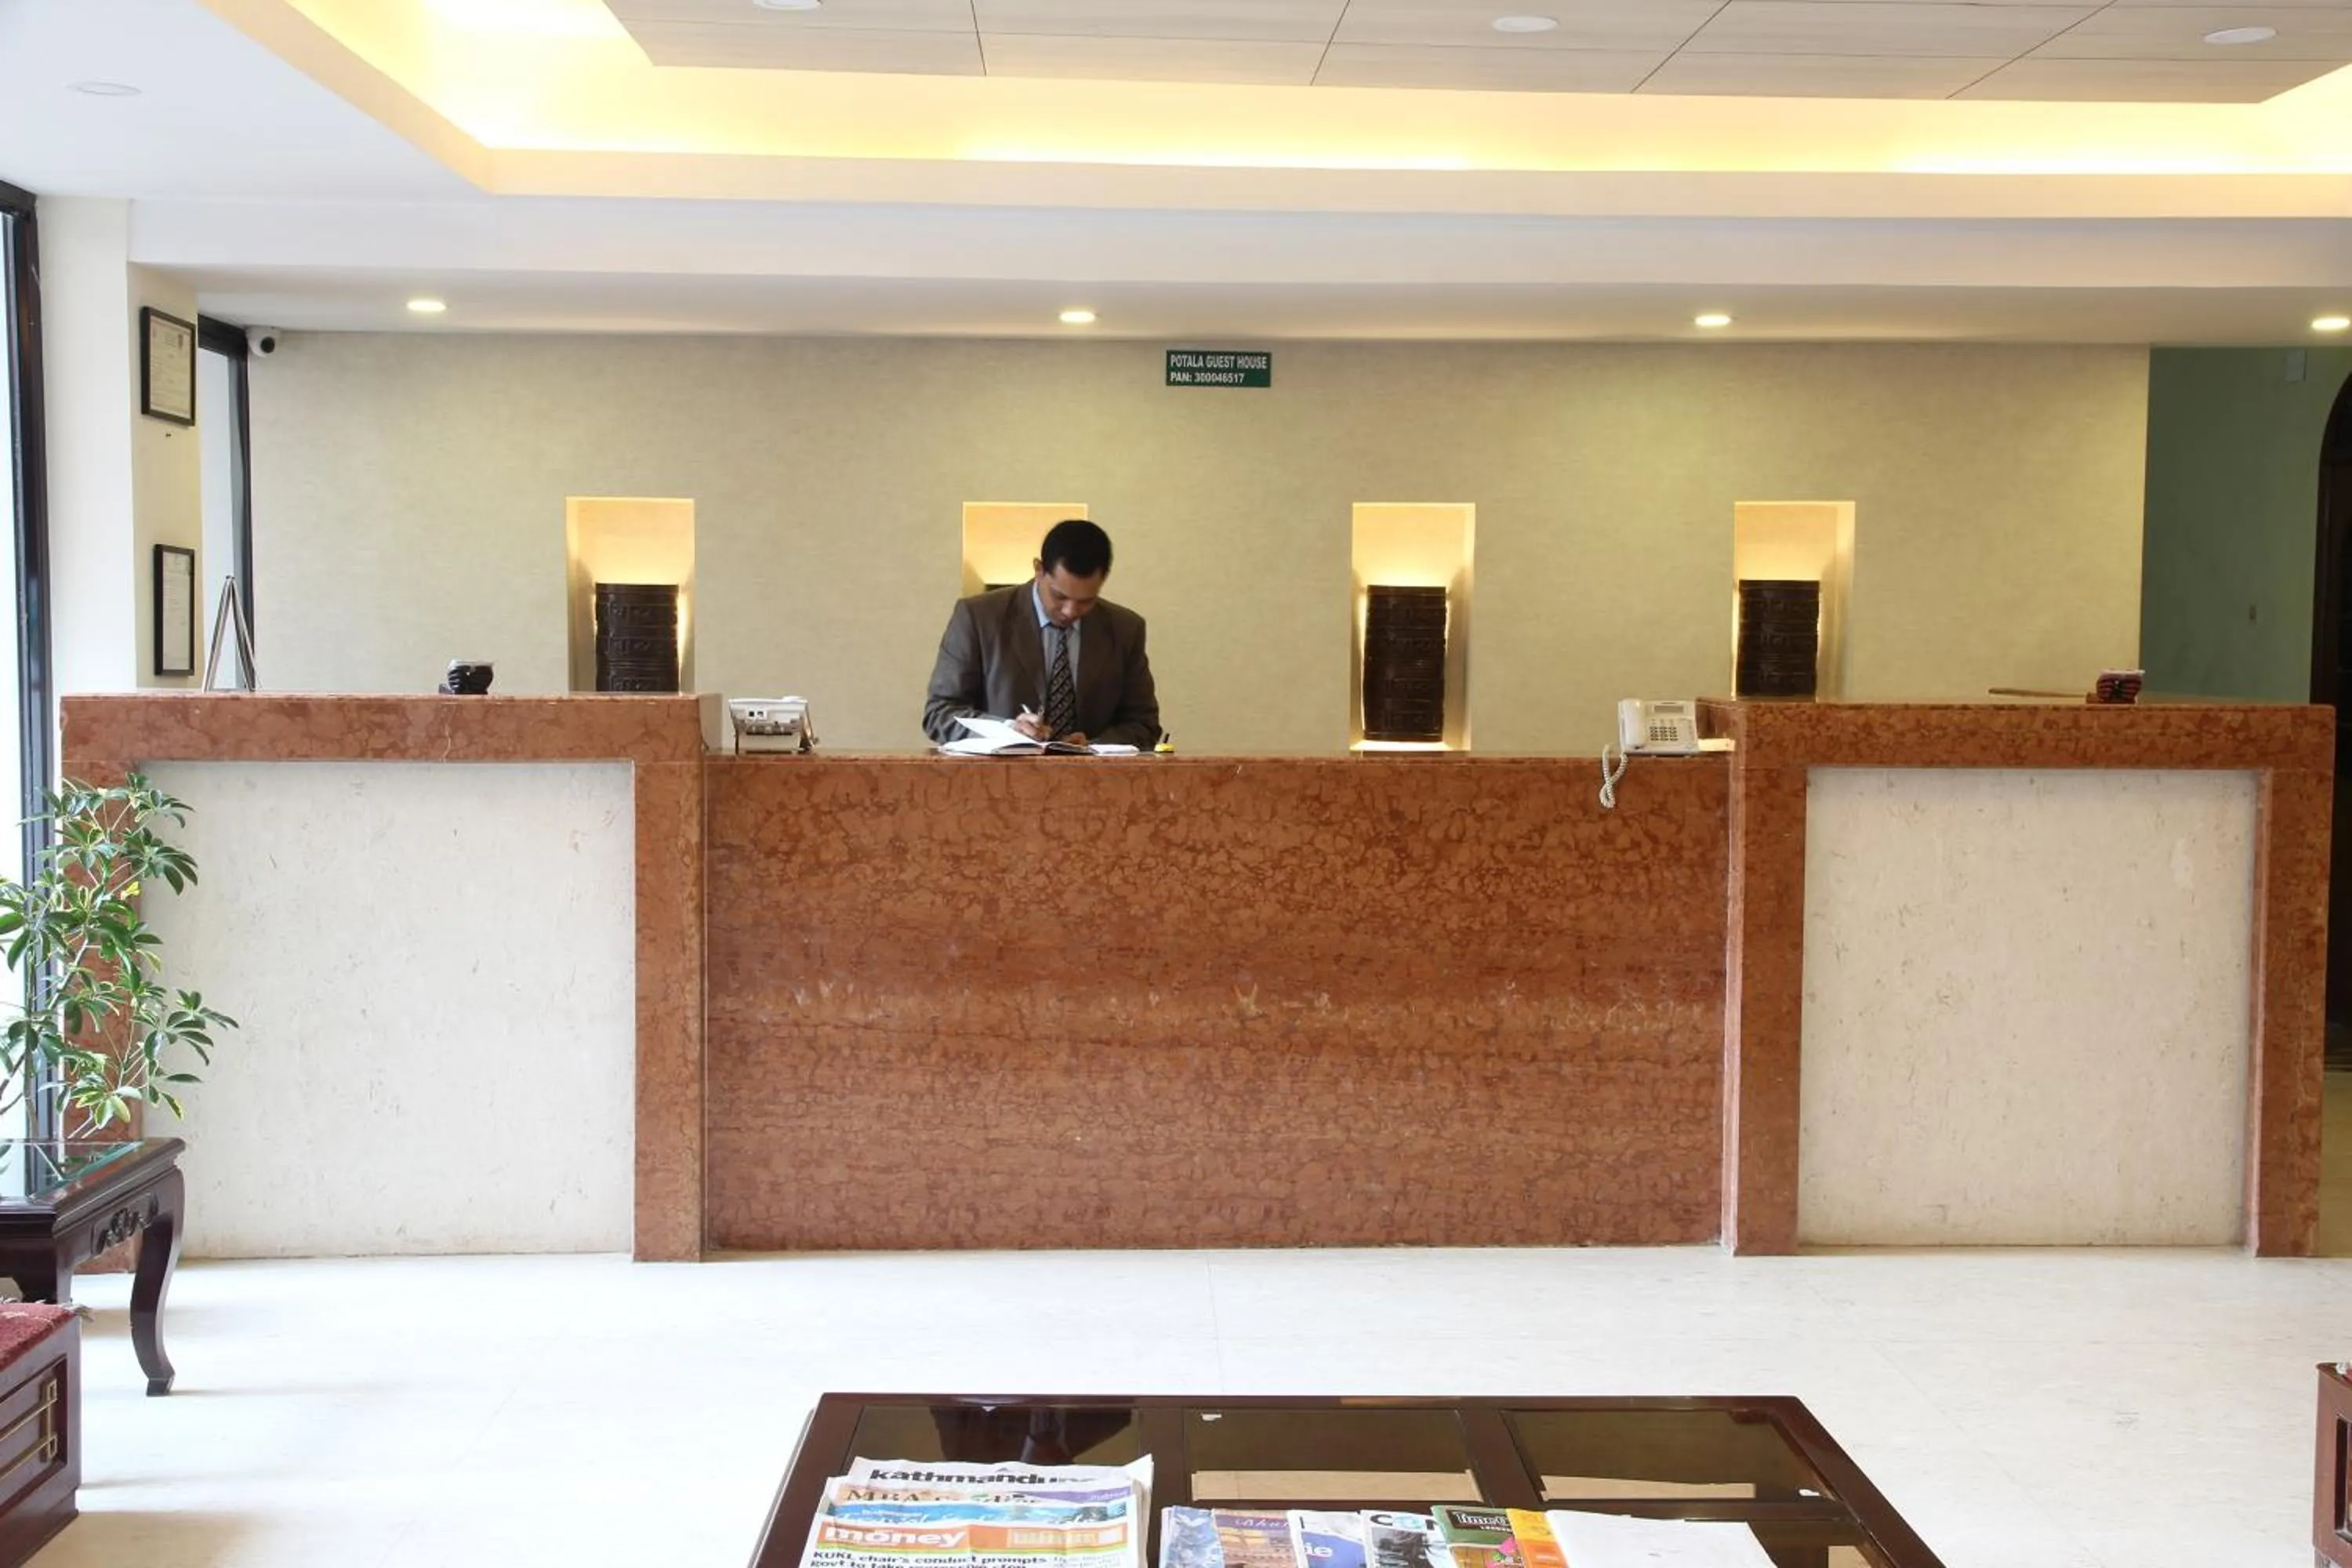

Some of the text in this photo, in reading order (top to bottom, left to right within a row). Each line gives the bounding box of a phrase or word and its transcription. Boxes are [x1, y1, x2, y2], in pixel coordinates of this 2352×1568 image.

[1170, 354, 1268, 369] POTALA GUEST HOUSE
[1170, 372, 1192, 383] PAN:
[869, 1468, 1047, 1484] kathmandu
[825, 1526, 965, 1547] money
